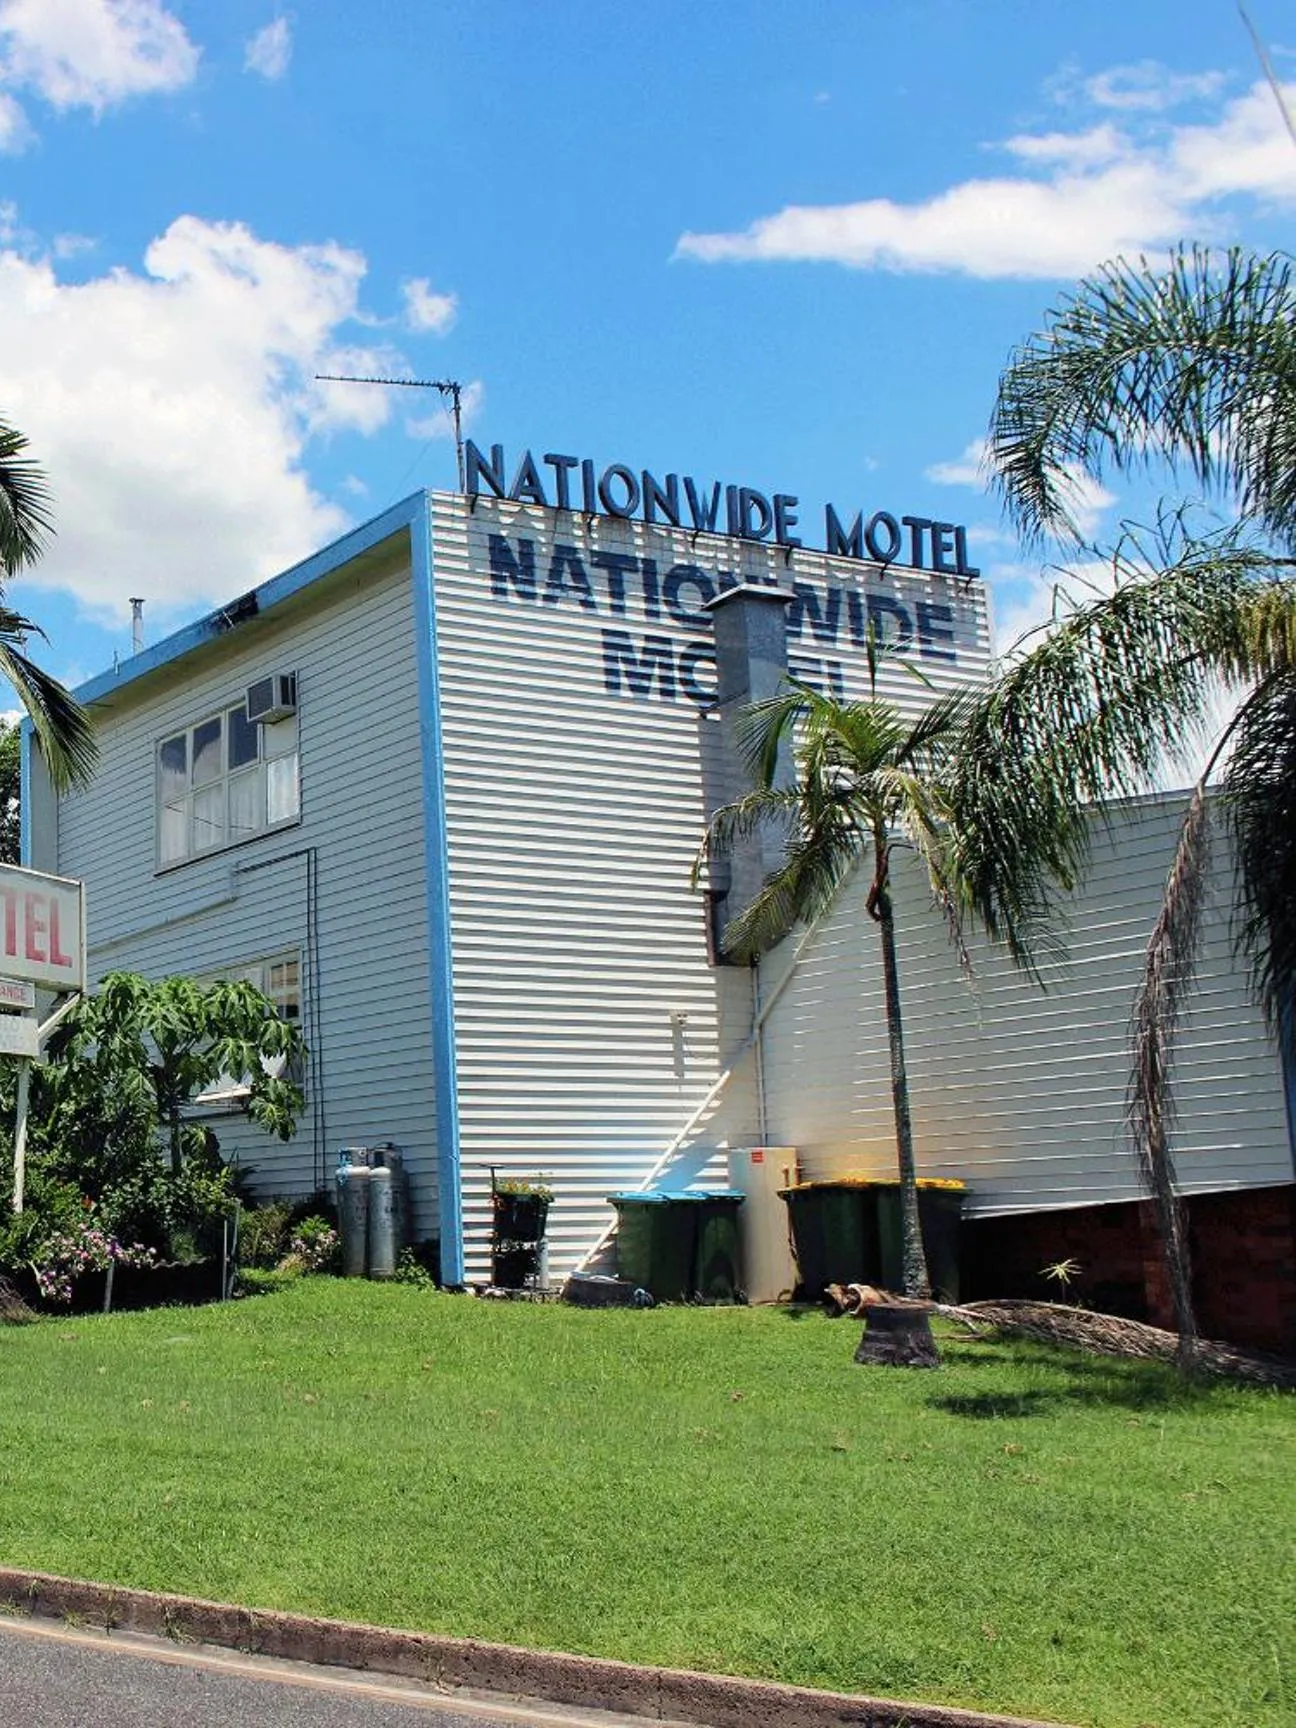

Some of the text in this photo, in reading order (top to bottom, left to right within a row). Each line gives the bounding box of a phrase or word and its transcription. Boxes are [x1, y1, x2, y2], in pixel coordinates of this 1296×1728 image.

[465, 439, 980, 577] NATIONWIDE MOTEL
[487, 533, 957, 661] NATIOWIDE
